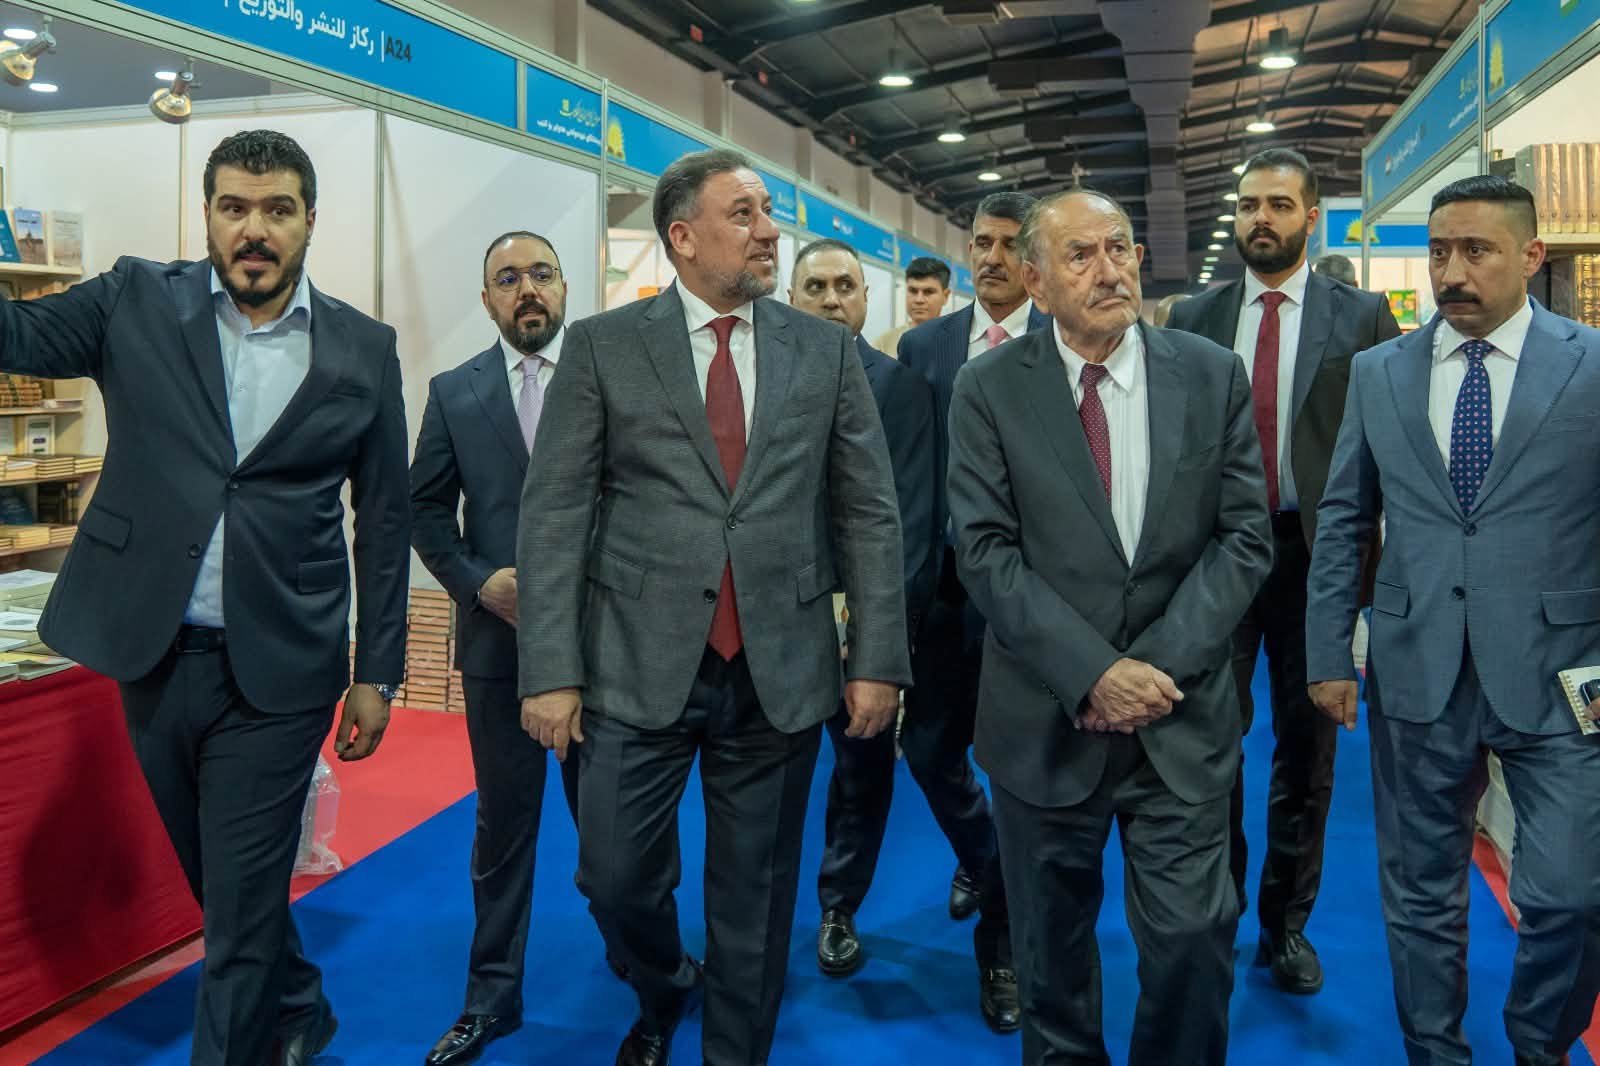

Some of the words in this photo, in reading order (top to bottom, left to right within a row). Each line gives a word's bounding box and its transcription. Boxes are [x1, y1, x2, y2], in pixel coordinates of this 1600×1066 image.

[308, 11, 346, 39] للنشر
[350, 25, 374, 56] ركاز
[385, 36, 413, 63] A24
